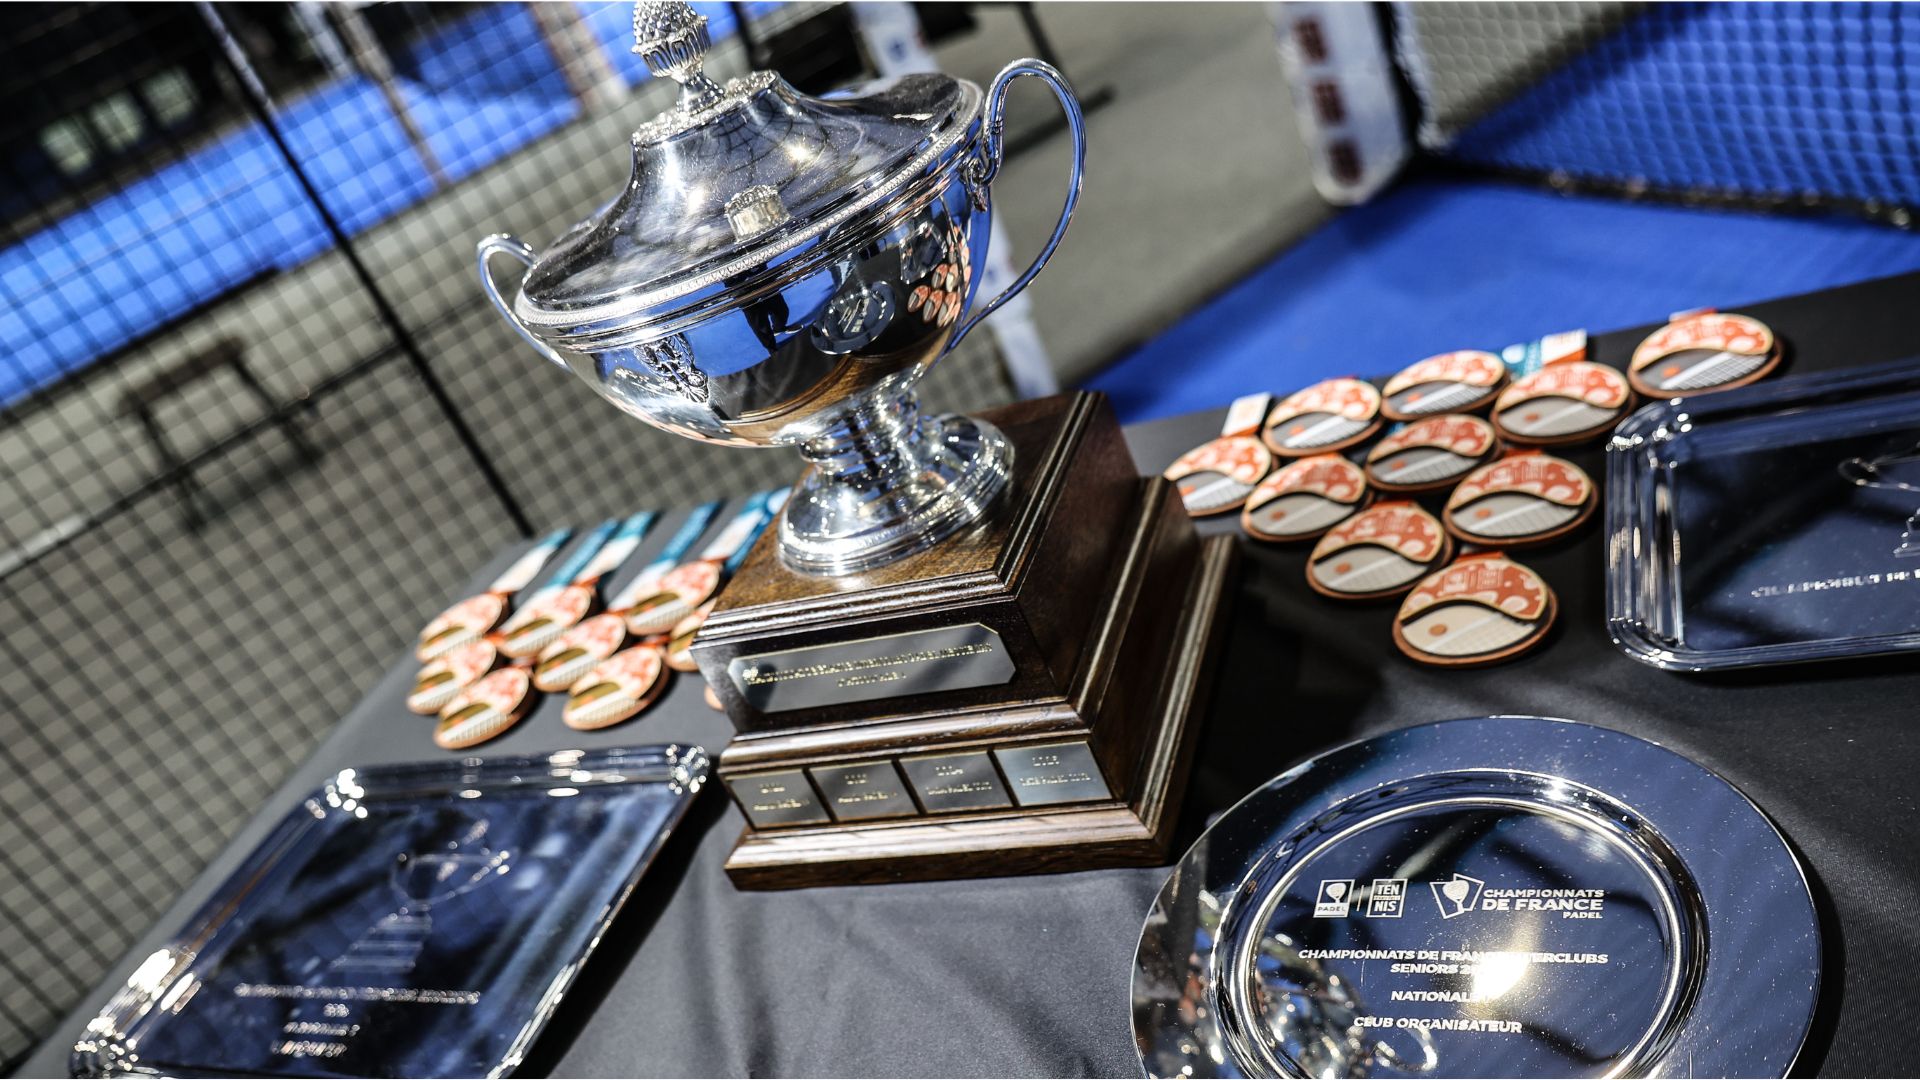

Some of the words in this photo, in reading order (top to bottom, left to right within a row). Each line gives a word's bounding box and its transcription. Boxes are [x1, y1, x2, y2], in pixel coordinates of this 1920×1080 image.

[1377, 884, 1400, 895] TEN
[1483, 889, 1605, 898] CHAMPIONNATS
[1374, 900, 1398, 912] NIS
[1482, 898, 1510, 911] DE
[1514, 898, 1604, 911] FRANCE
[1562, 911, 1603, 919] PADEL
[1298, 949, 1415, 960] CHAMPIONNATS
[1417, 950, 1439, 961] DE
[1440, 950, 1500, 962] FRAN
[1390, 963, 1459, 975] SENIORS
[1391, 990, 1481, 1003] NATIONALE
[1353, 1016, 1394, 1028] CLUB
[1396, 1017, 1523, 1034] ORGANISATEUR
